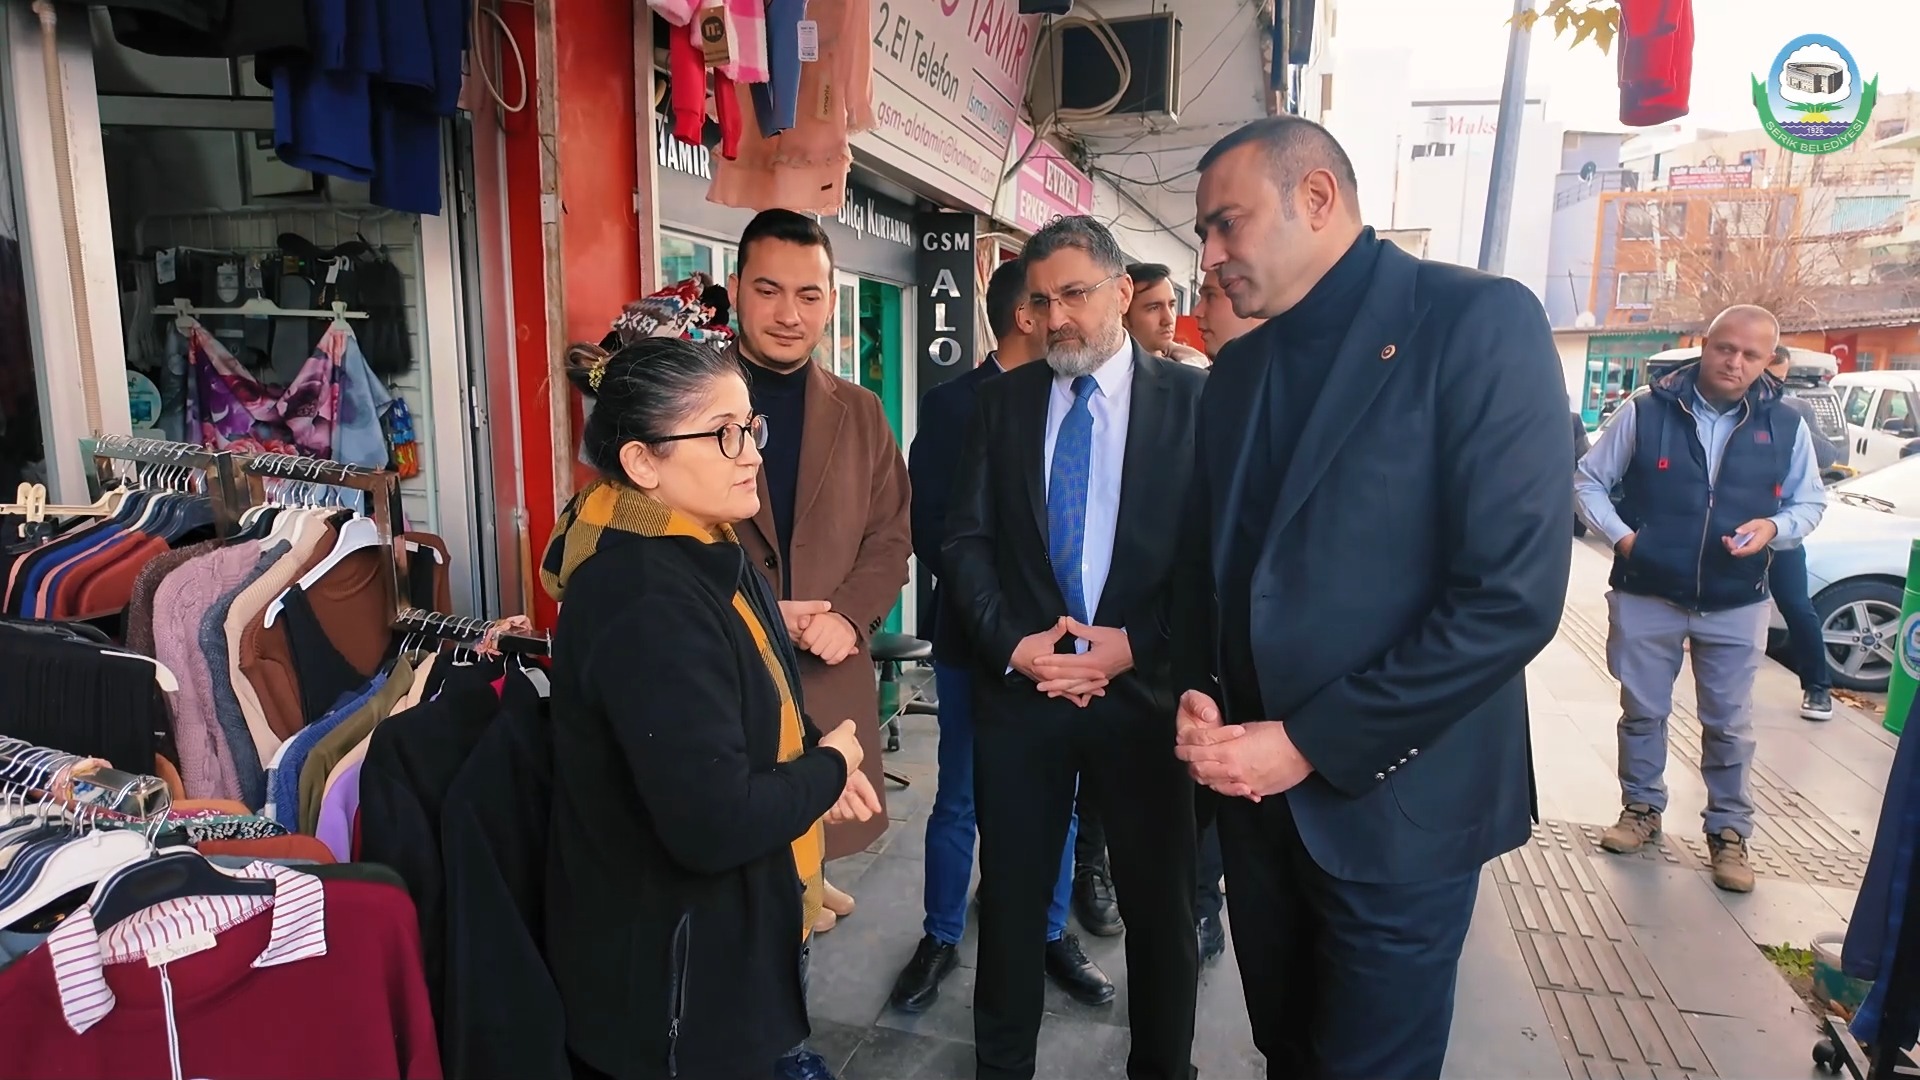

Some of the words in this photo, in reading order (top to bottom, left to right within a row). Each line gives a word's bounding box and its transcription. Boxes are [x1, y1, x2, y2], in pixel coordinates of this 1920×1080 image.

[873, 2, 911, 63] 2.El
[910, 29, 959, 103] Telefon
[1045, 158, 1079, 210] EVREN
[867, 198, 911, 246] KURTARMA
[923, 232, 970, 251] GSM
